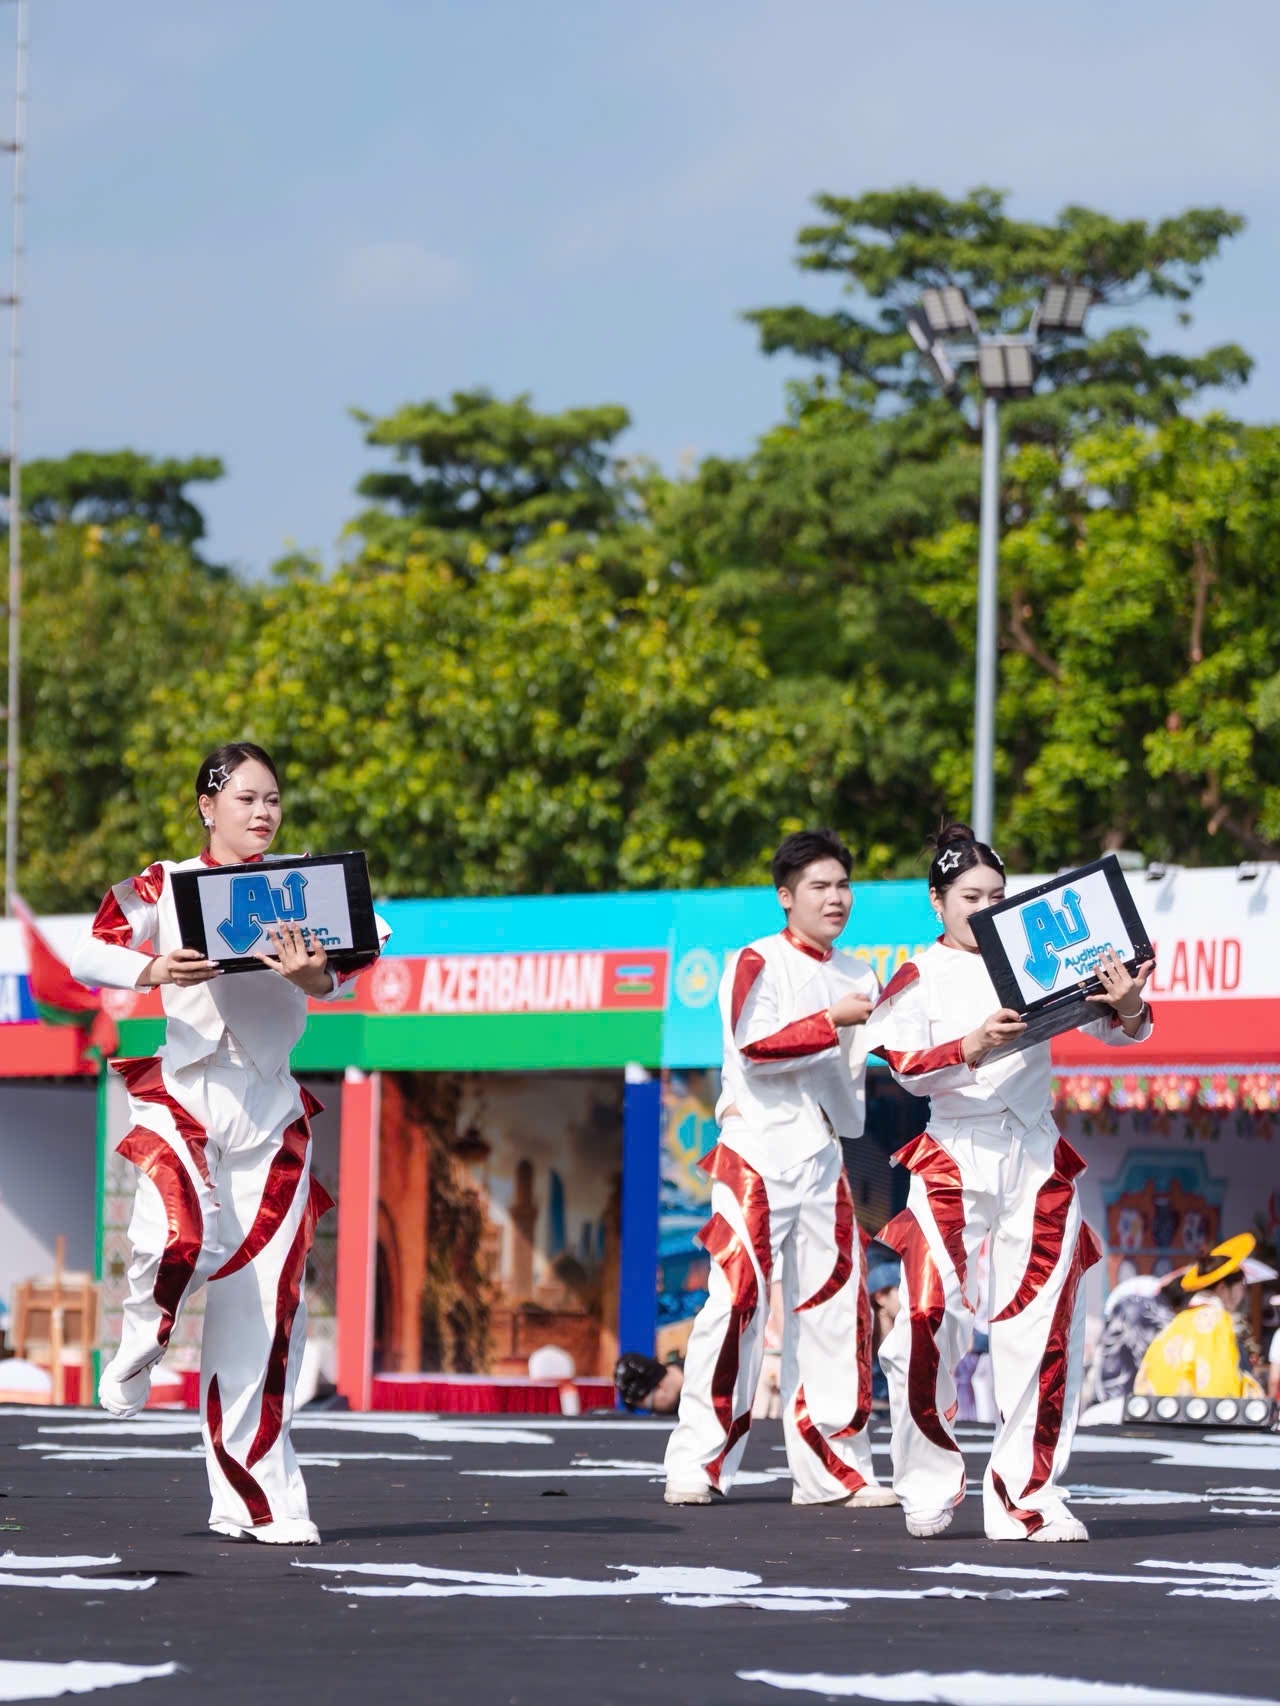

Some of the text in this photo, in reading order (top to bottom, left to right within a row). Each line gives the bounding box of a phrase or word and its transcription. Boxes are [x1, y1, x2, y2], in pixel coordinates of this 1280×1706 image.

[1064, 941, 1113, 969] Audition
[1149, 938, 1242, 992] LAND
[420, 954, 604, 1013] AZERBAIJAN
